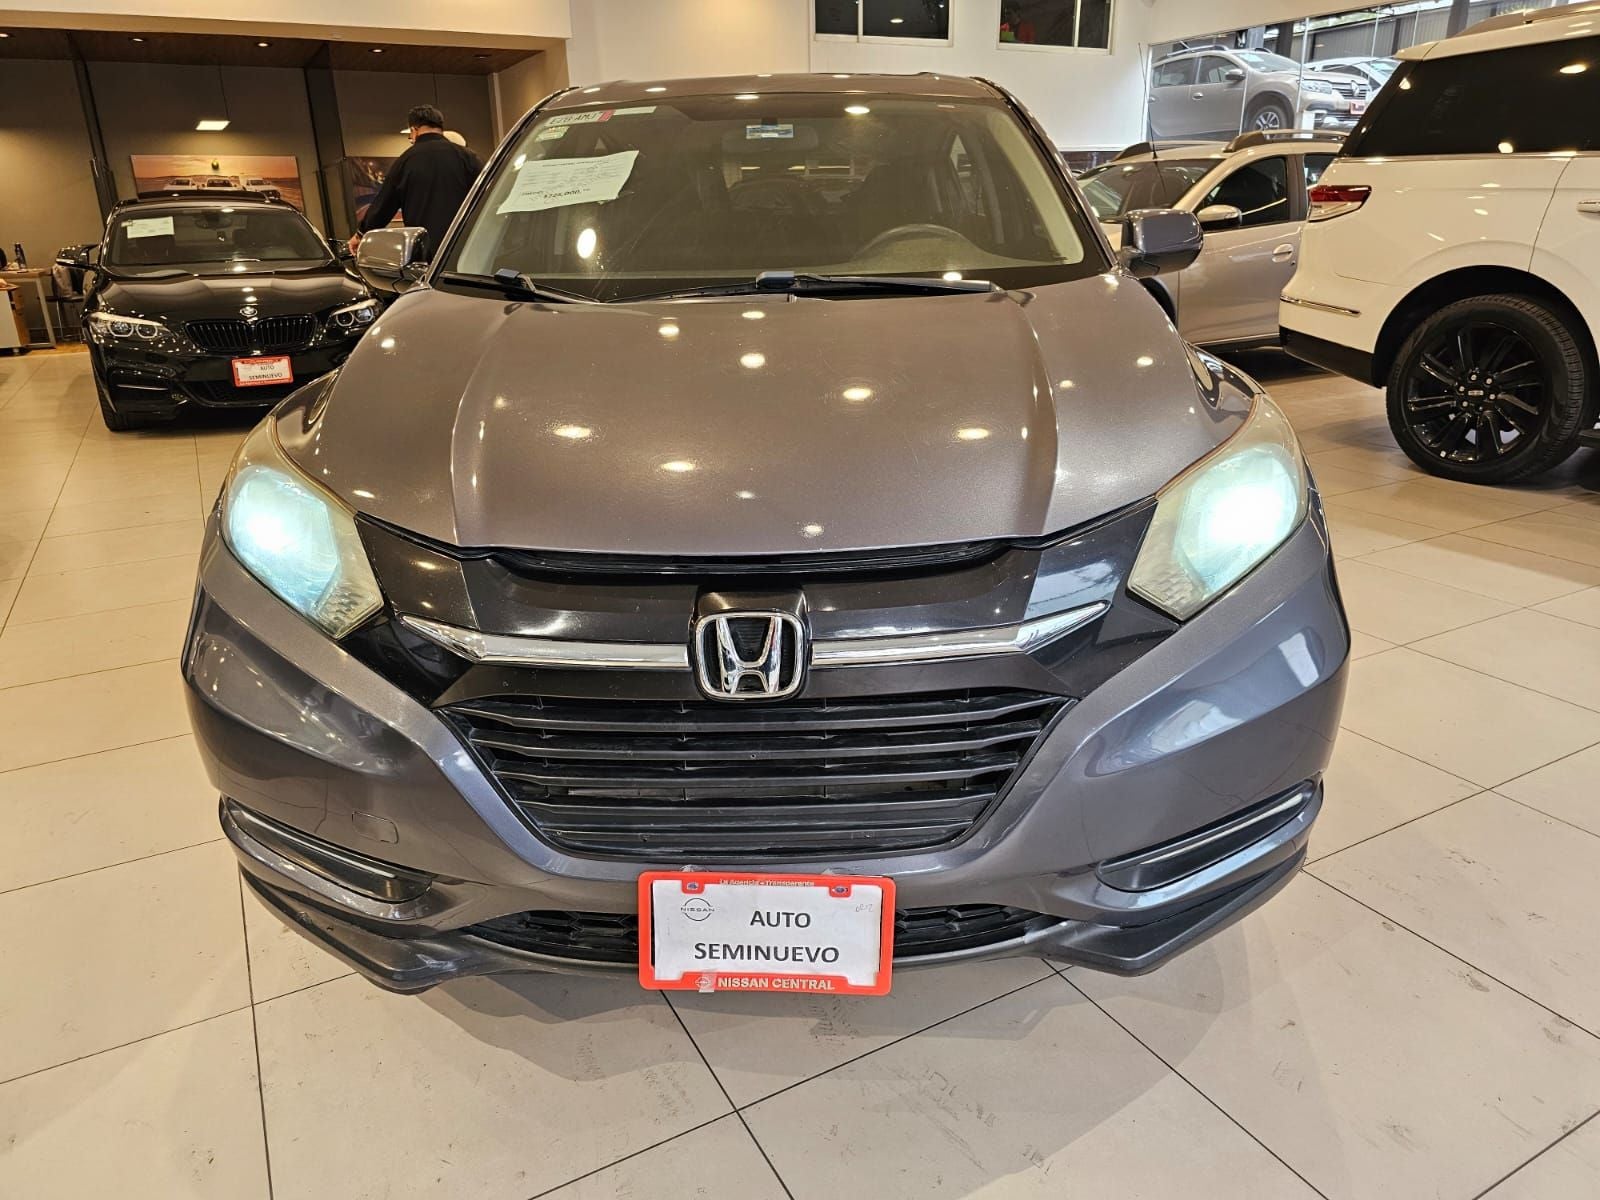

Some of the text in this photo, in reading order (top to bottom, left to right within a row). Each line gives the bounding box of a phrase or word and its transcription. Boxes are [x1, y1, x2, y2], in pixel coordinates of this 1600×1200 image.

[750, 910, 811, 929] AUTO
[694, 942, 840, 963] SEMINUEVO
[717, 977, 769, 988] NISSAN
[772, 978, 835, 990] CENTRAL
